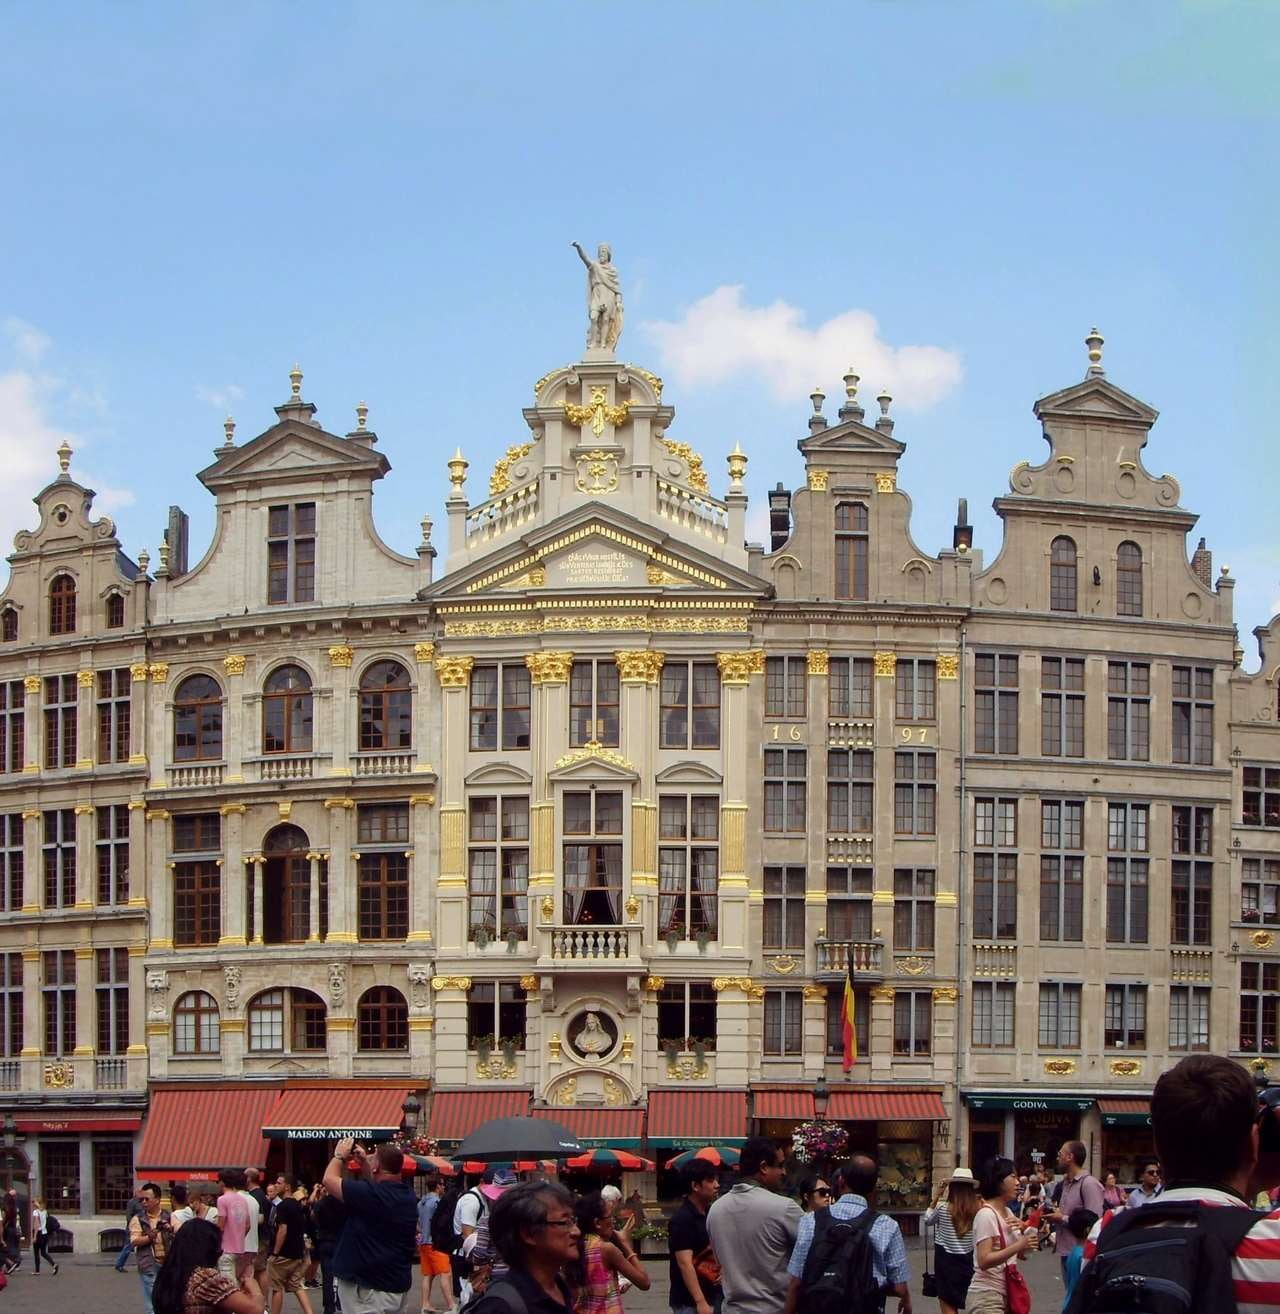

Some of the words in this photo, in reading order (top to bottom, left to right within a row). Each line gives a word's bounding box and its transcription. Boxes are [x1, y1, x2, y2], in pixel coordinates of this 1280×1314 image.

[772, 725, 801, 741] 16
[902, 727, 927, 743] 97
[1013, 1101, 1048, 1109] GODIVA
[1024, 1112, 1070, 1123] GODIVA
[287, 1130, 325, 1139] MAISON
[327, 1130, 373, 1139] ANTOINE
